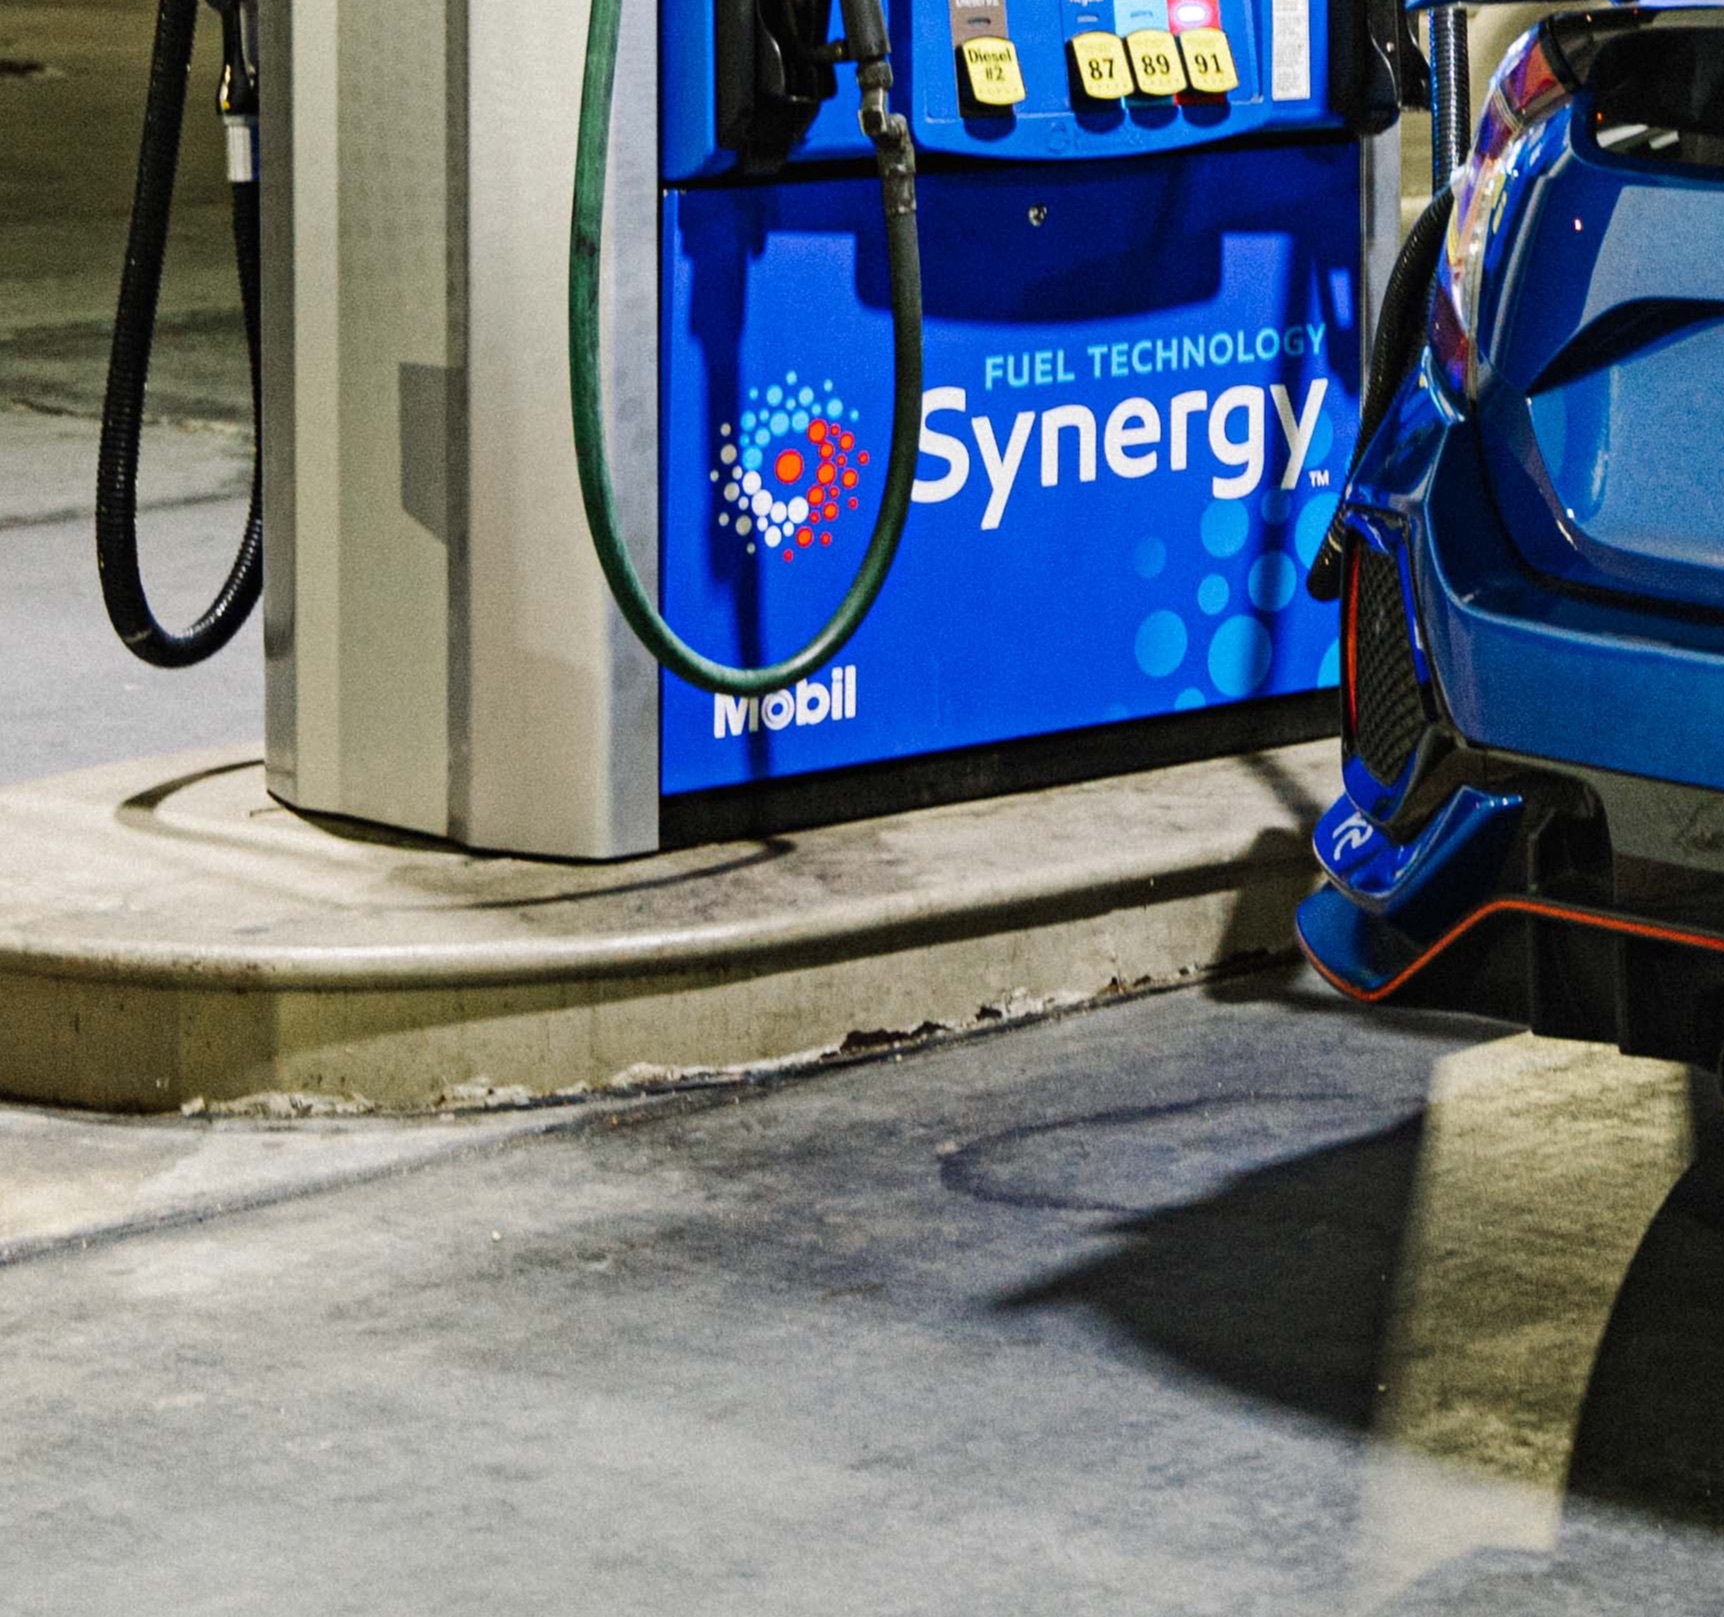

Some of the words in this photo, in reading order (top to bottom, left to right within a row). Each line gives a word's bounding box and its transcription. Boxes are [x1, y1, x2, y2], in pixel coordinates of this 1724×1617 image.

[968, 47, 1012, 65] Diesel
[1141, 54, 1171, 76] 89
[1194, 53, 1224, 75] 91
[985, 67, 1004, 82] #2
[1088, 58, 1115, 81] 87
[984, 350, 1074, 392] FUEL
[1087, 322, 1327, 378] TECHNOLOGY
[910, 378, 1329, 530] Synergy
[713, 665, 857, 739] Mobil
